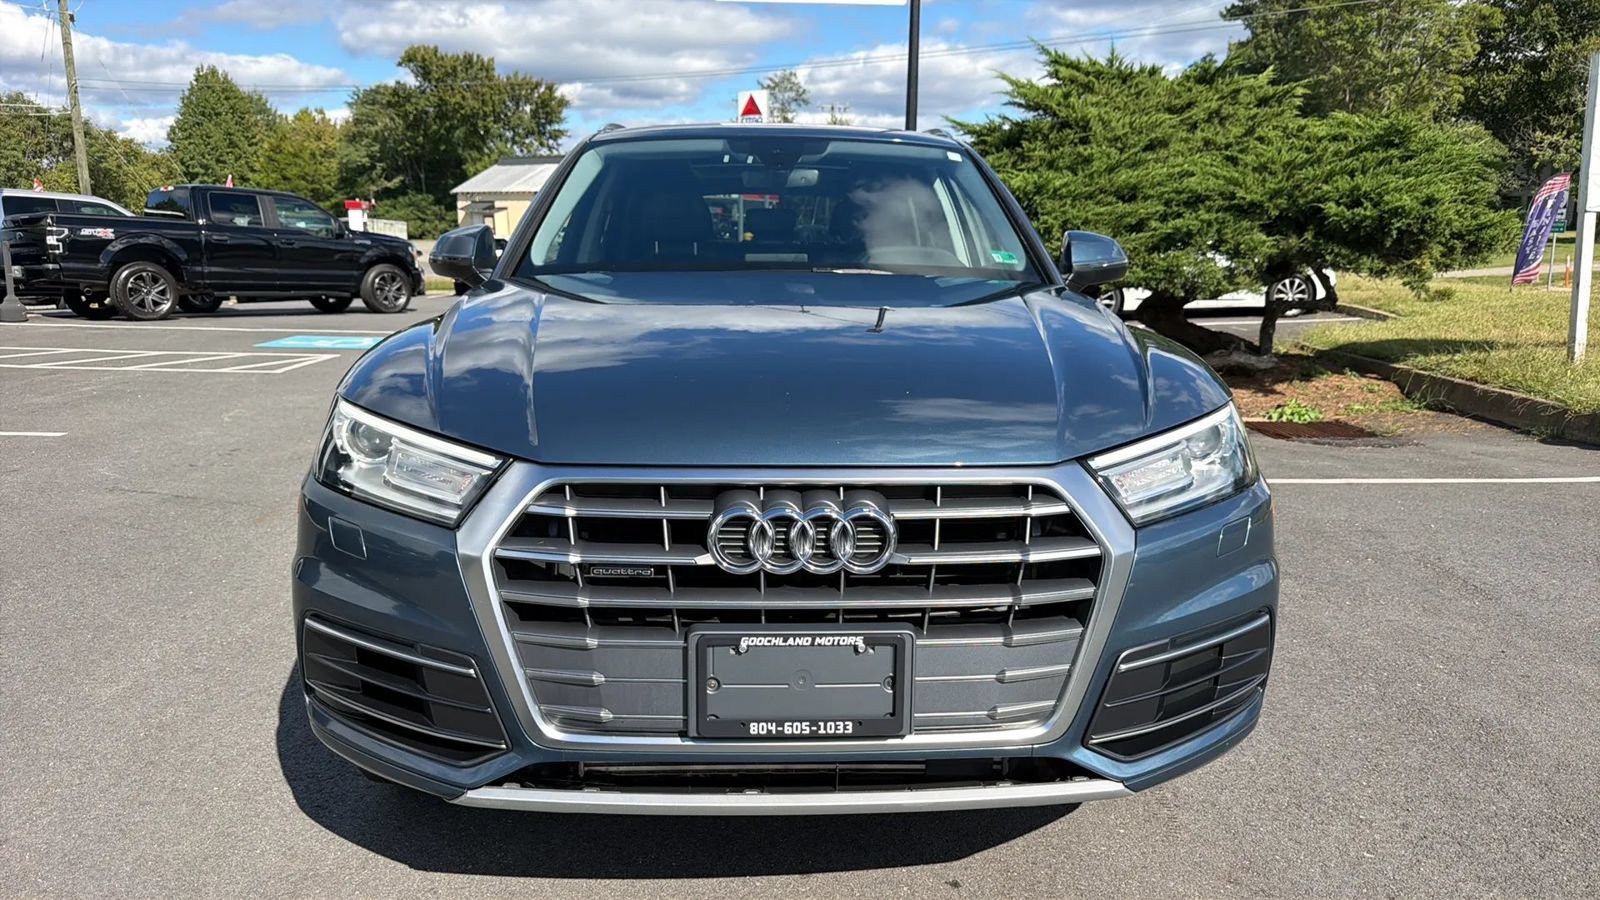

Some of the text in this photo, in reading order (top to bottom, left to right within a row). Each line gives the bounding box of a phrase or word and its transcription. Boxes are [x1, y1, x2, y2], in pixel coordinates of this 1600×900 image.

[593, 568, 651, 576] quattro
[740, 636, 864, 646] GOOCHLAND MOTORS
[749, 721, 853, 735] 804-605-1033
